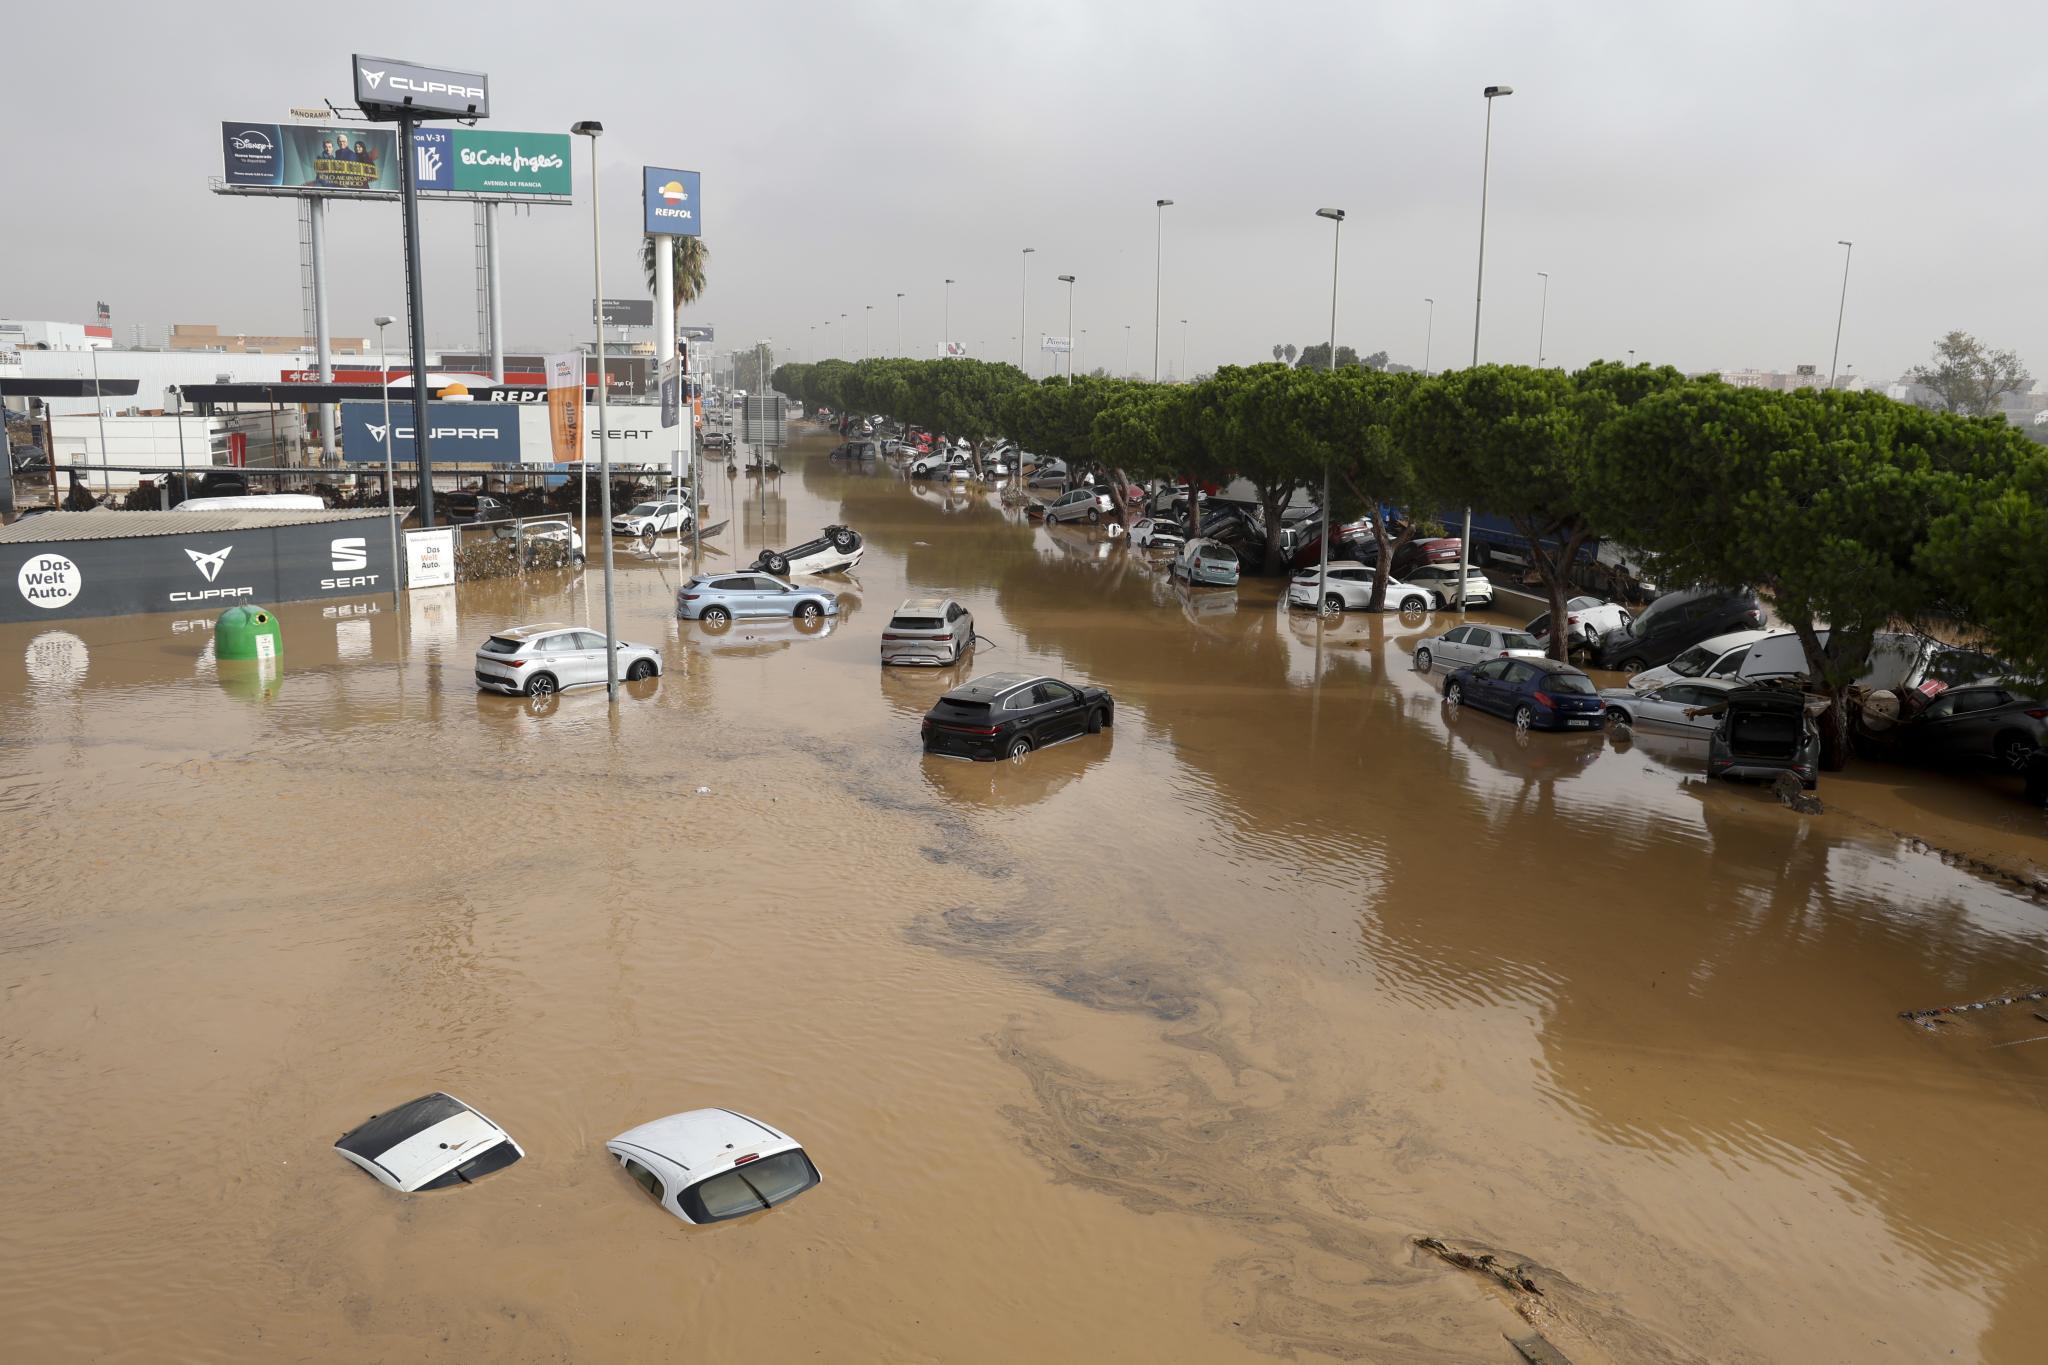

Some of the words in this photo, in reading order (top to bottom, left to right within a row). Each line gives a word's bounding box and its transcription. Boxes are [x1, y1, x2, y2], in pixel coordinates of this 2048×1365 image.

[389, 76, 485, 99] CUPRA
[290, 109, 331, 118] PANORAMIX
[230, 133, 274, 153] Disney+
[426, 134, 446, 142] V-31
[460, 148, 478, 165] El
[477, 149, 513, 167] Corte
[513, 146, 563, 173] Inglés
[655, 207, 692, 219] REPSOL
[491, 391, 547, 402] REPS
[591, 430, 653, 439] SEAT
[40, 559, 71, 571] Das
[25, 571, 65, 585] Welt
[320, 575, 379, 590] SEAT
[28, 587, 71, 599] Auto.
[169, 586, 253, 601] CUPRA
